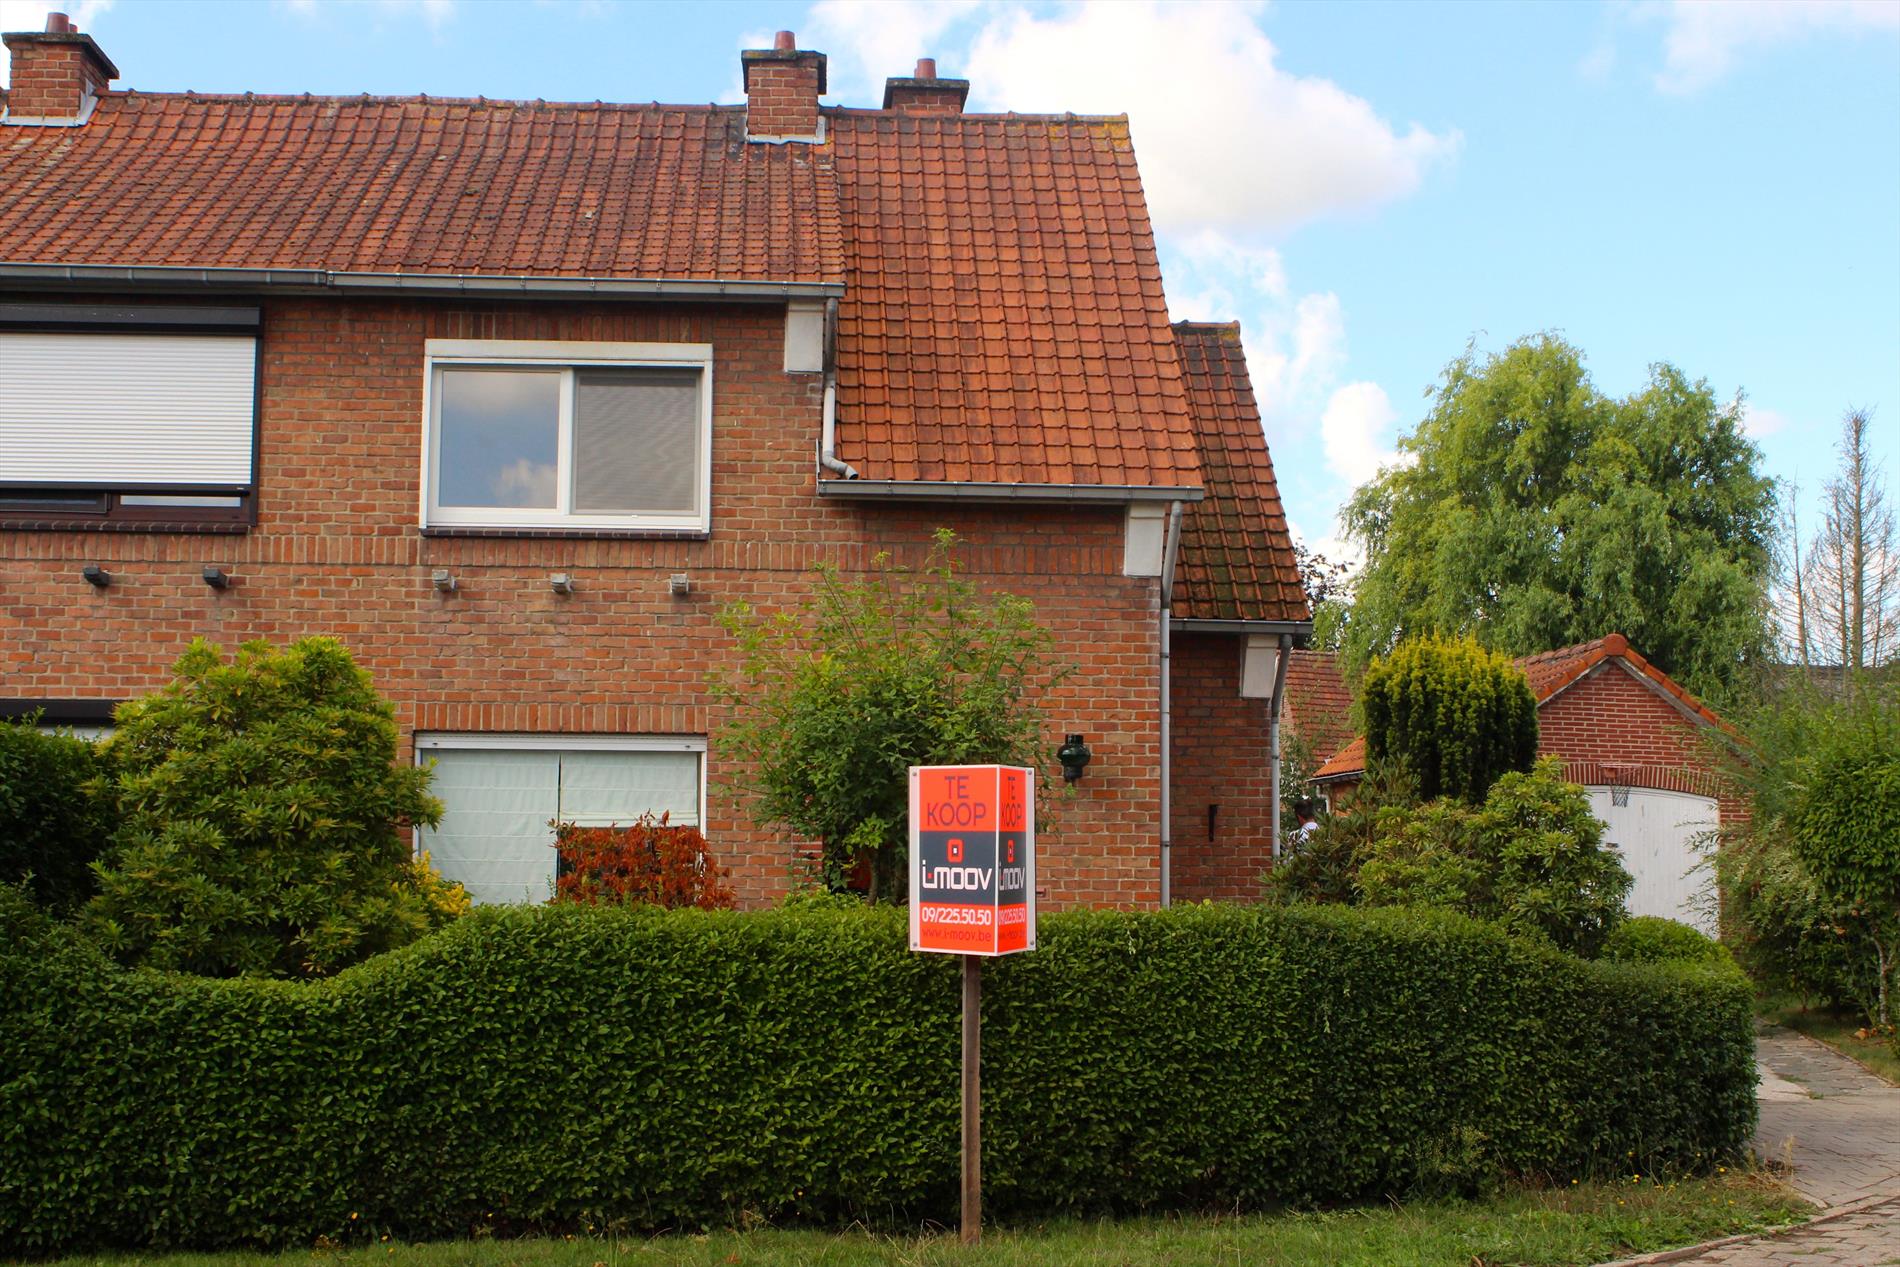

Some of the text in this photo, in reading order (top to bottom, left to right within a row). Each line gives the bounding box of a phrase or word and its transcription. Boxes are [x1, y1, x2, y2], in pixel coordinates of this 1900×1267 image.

[944, 775, 969, 800] TE
[926, 802, 986, 826] KOOP
[1001, 803, 1022, 827] KOOP
[922, 907, 992, 925] 09/225.50.50
[922, 928, 992, 942] www.i-moov.be
